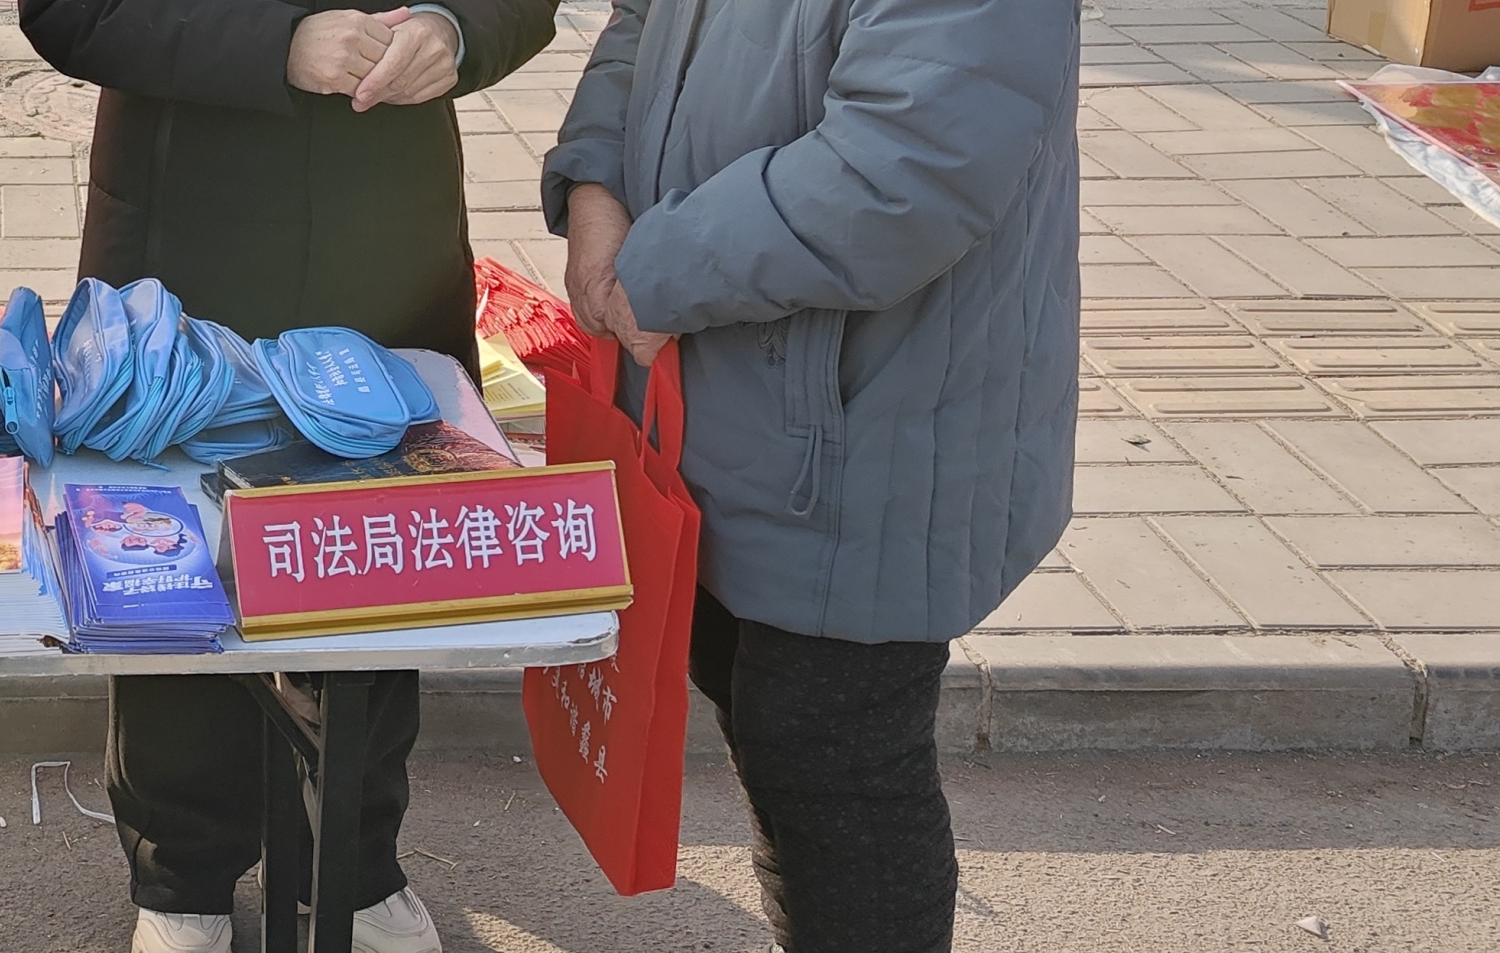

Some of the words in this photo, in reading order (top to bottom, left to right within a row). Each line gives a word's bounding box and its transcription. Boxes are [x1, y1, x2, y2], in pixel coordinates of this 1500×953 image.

[262, 498, 597, 583] 司法局法律咨询
